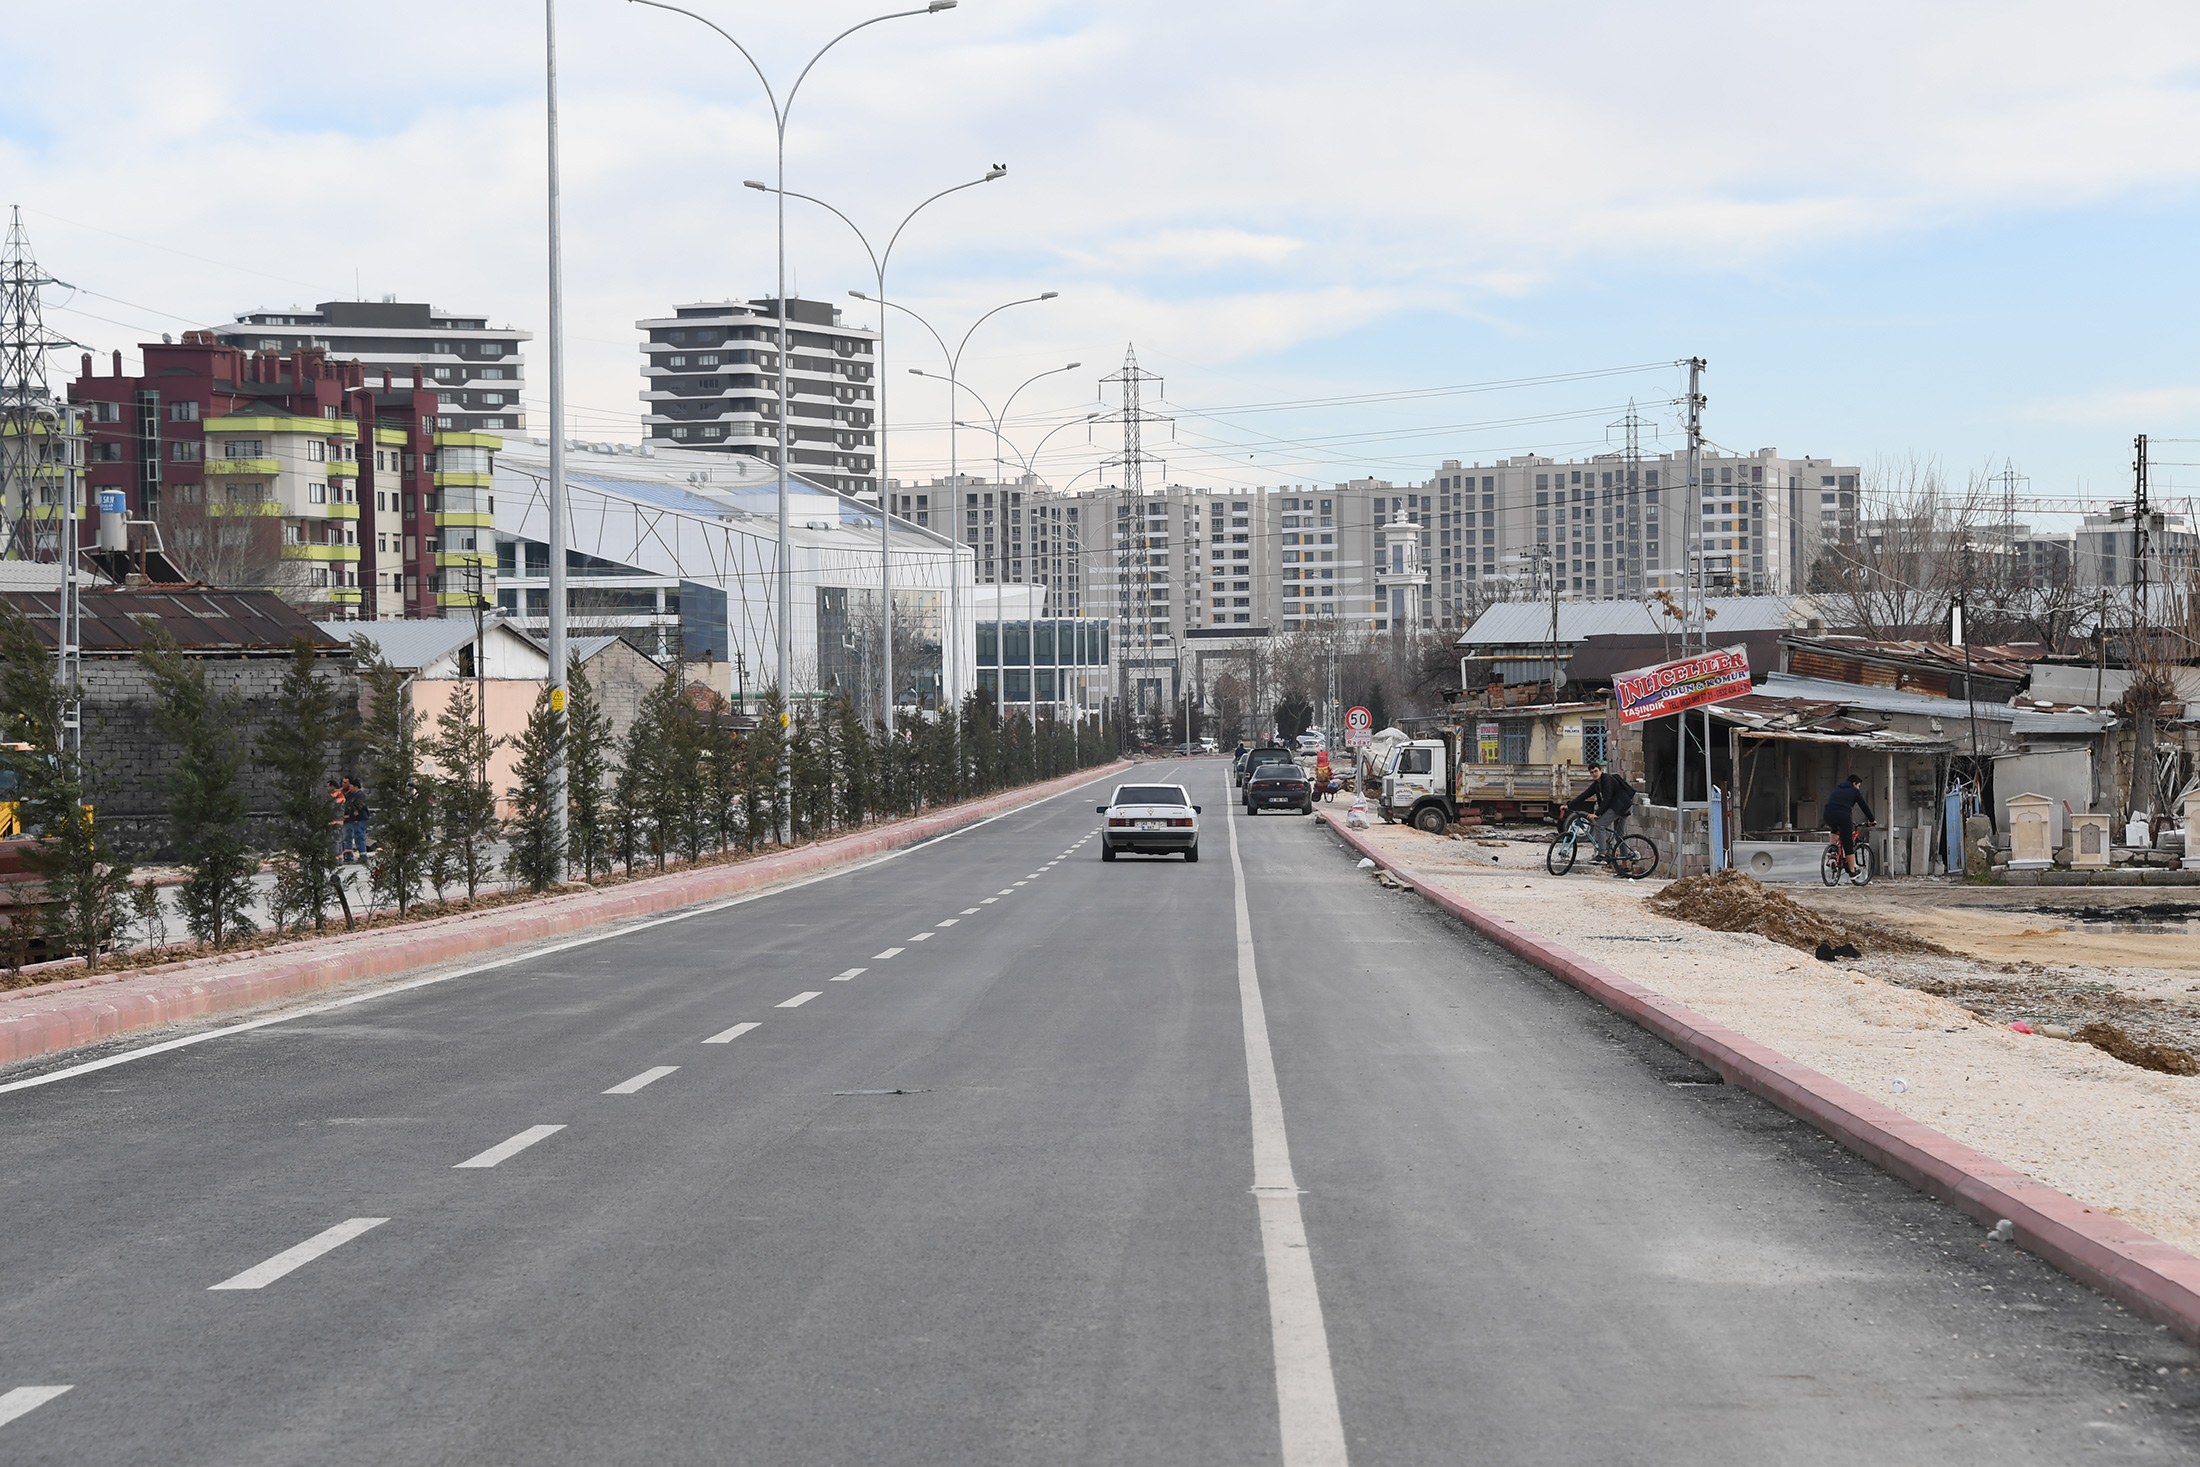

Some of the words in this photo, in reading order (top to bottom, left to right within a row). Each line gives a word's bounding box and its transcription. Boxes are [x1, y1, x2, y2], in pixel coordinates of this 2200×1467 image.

[1618, 652, 1745, 708] İNLİCELİLER
[1662, 684, 1694, 698] ODUN
[1696, 682, 1704, 690] &
[1623, 702, 1665, 717] TAŞINDIK
[1668, 702, 1679, 710] TEL:
[1351, 714, 1366, 725] 50
